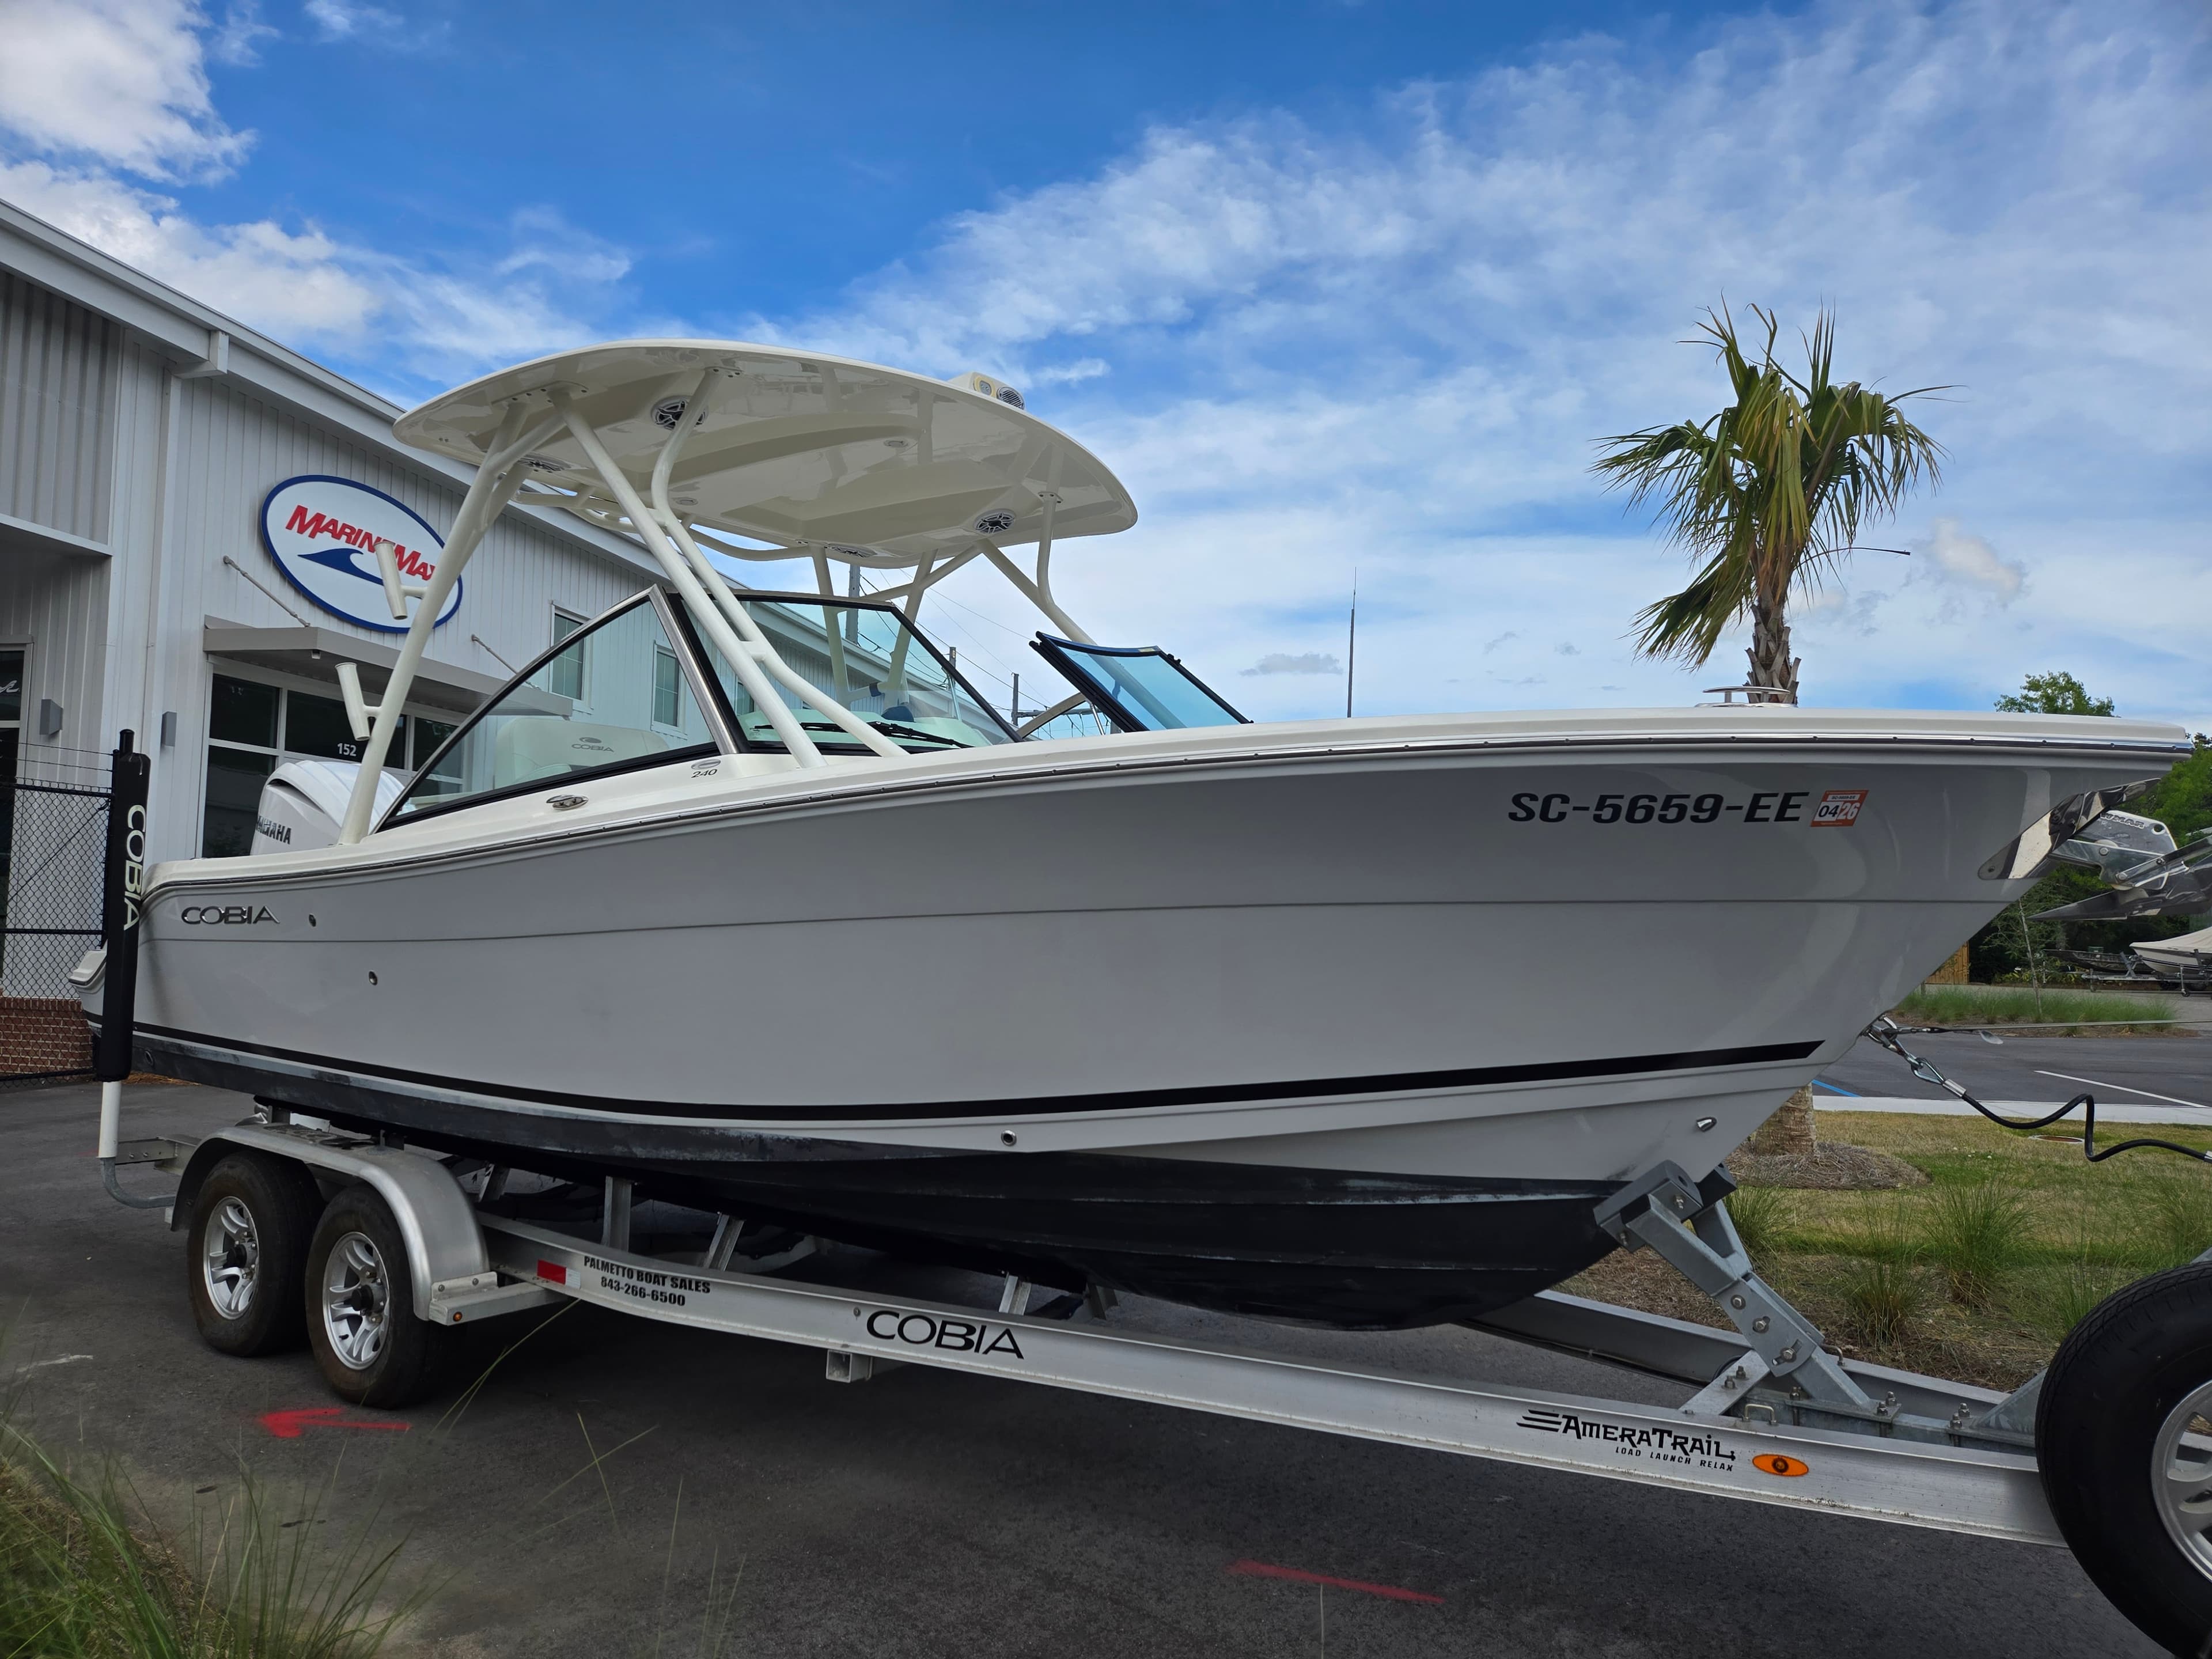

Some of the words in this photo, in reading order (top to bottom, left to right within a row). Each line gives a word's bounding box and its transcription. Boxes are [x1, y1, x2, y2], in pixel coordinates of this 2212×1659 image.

[286, 505, 435, 581] MARINMA
[338, 743, 357, 756] 152
[571, 743, 614, 752] COBIA
[691, 768, 718, 778] 240
[1508, 792, 1810, 824] SC-5659-EE
[1819, 805, 1840, 817] 04
[1837, 802, 1860, 820] 26
[124, 804, 146, 931] COBIA
[181, 906, 281, 925] COBIA
[584, 1256, 634, 1280] PALMETTO
[637, 1271, 667, 1286] BOAT
[671, 1277, 710, 1294] SALES
[601, 1277, 685, 1306] 843-266-6500
[866, 1310, 1024, 1359] COBIA
[1615, 1446, 1641, 1457] LOAD
[1650, 1452, 1691, 1465] LAUNCH
[1699, 1460, 1733, 1472] RELAX
